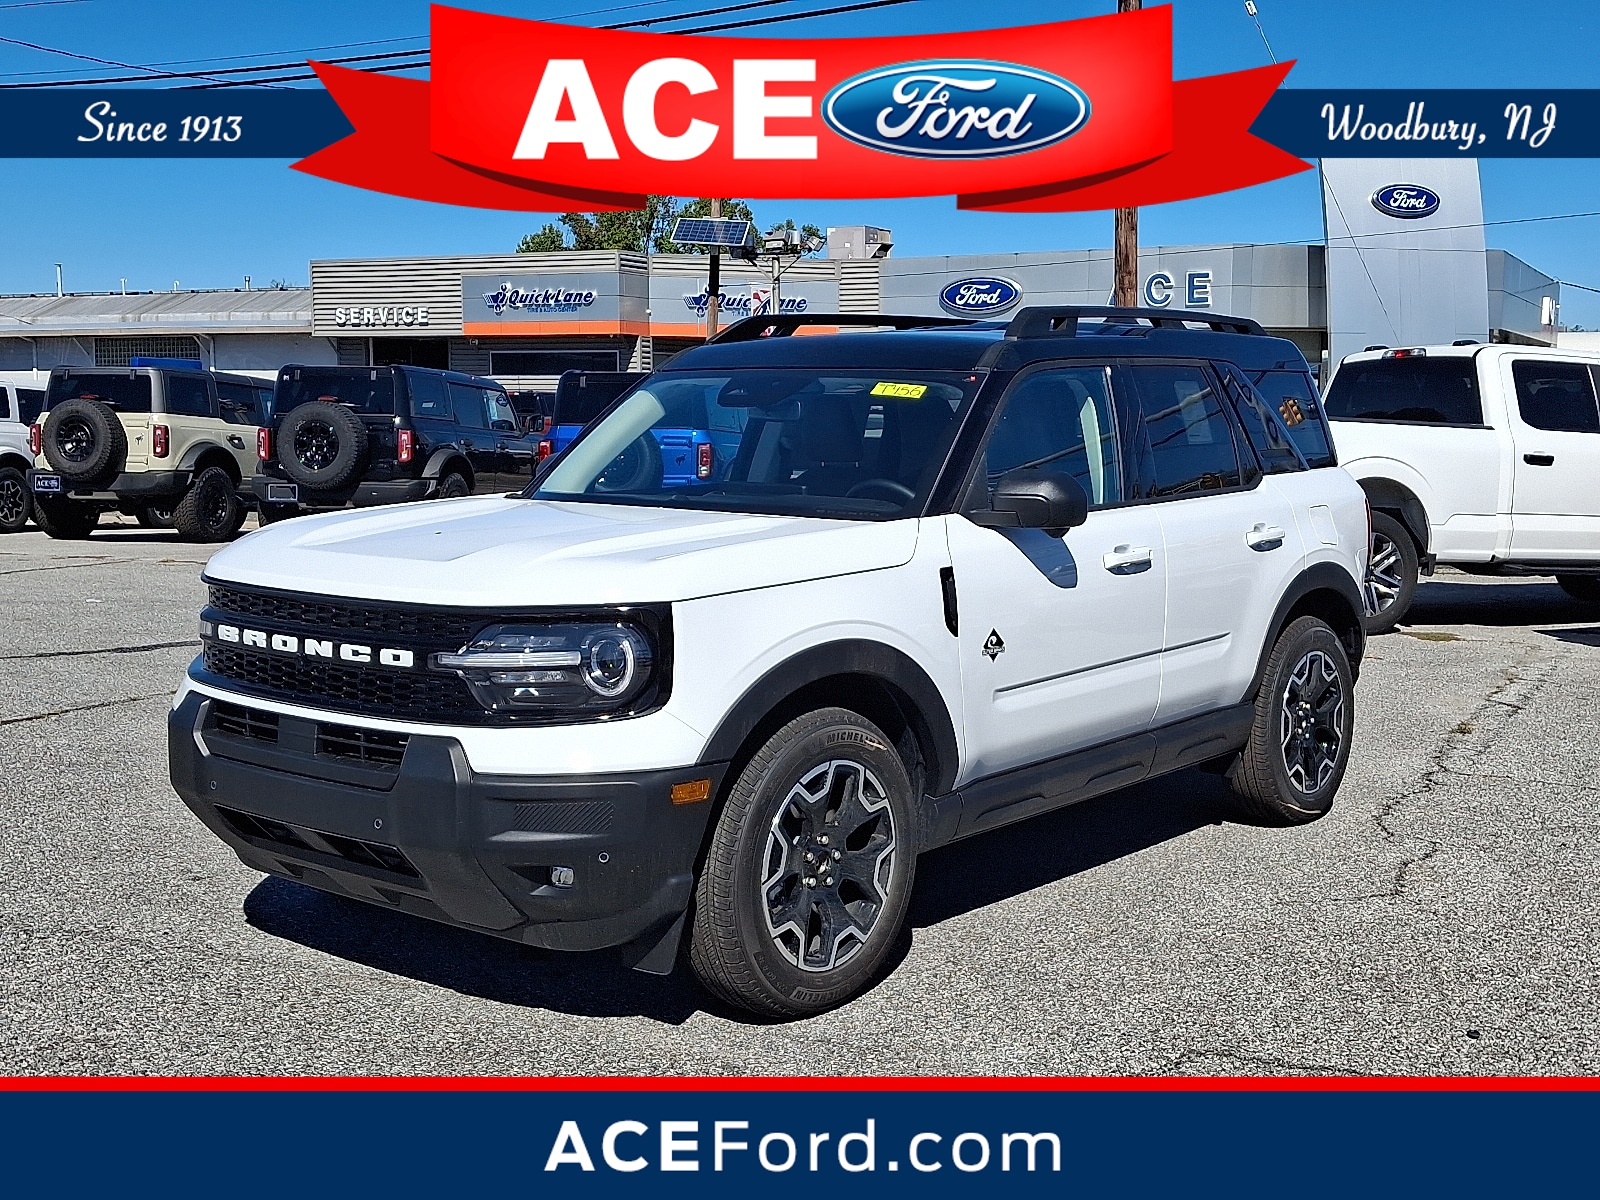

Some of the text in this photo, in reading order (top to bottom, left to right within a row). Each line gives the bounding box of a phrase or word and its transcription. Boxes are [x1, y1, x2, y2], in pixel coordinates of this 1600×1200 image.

[1390, 190, 1427, 208] Ford
[955, 284, 1001, 305] Ford
[335, 307, 430, 326] SERVICE
[218, 624, 414, 668] BRONCO
